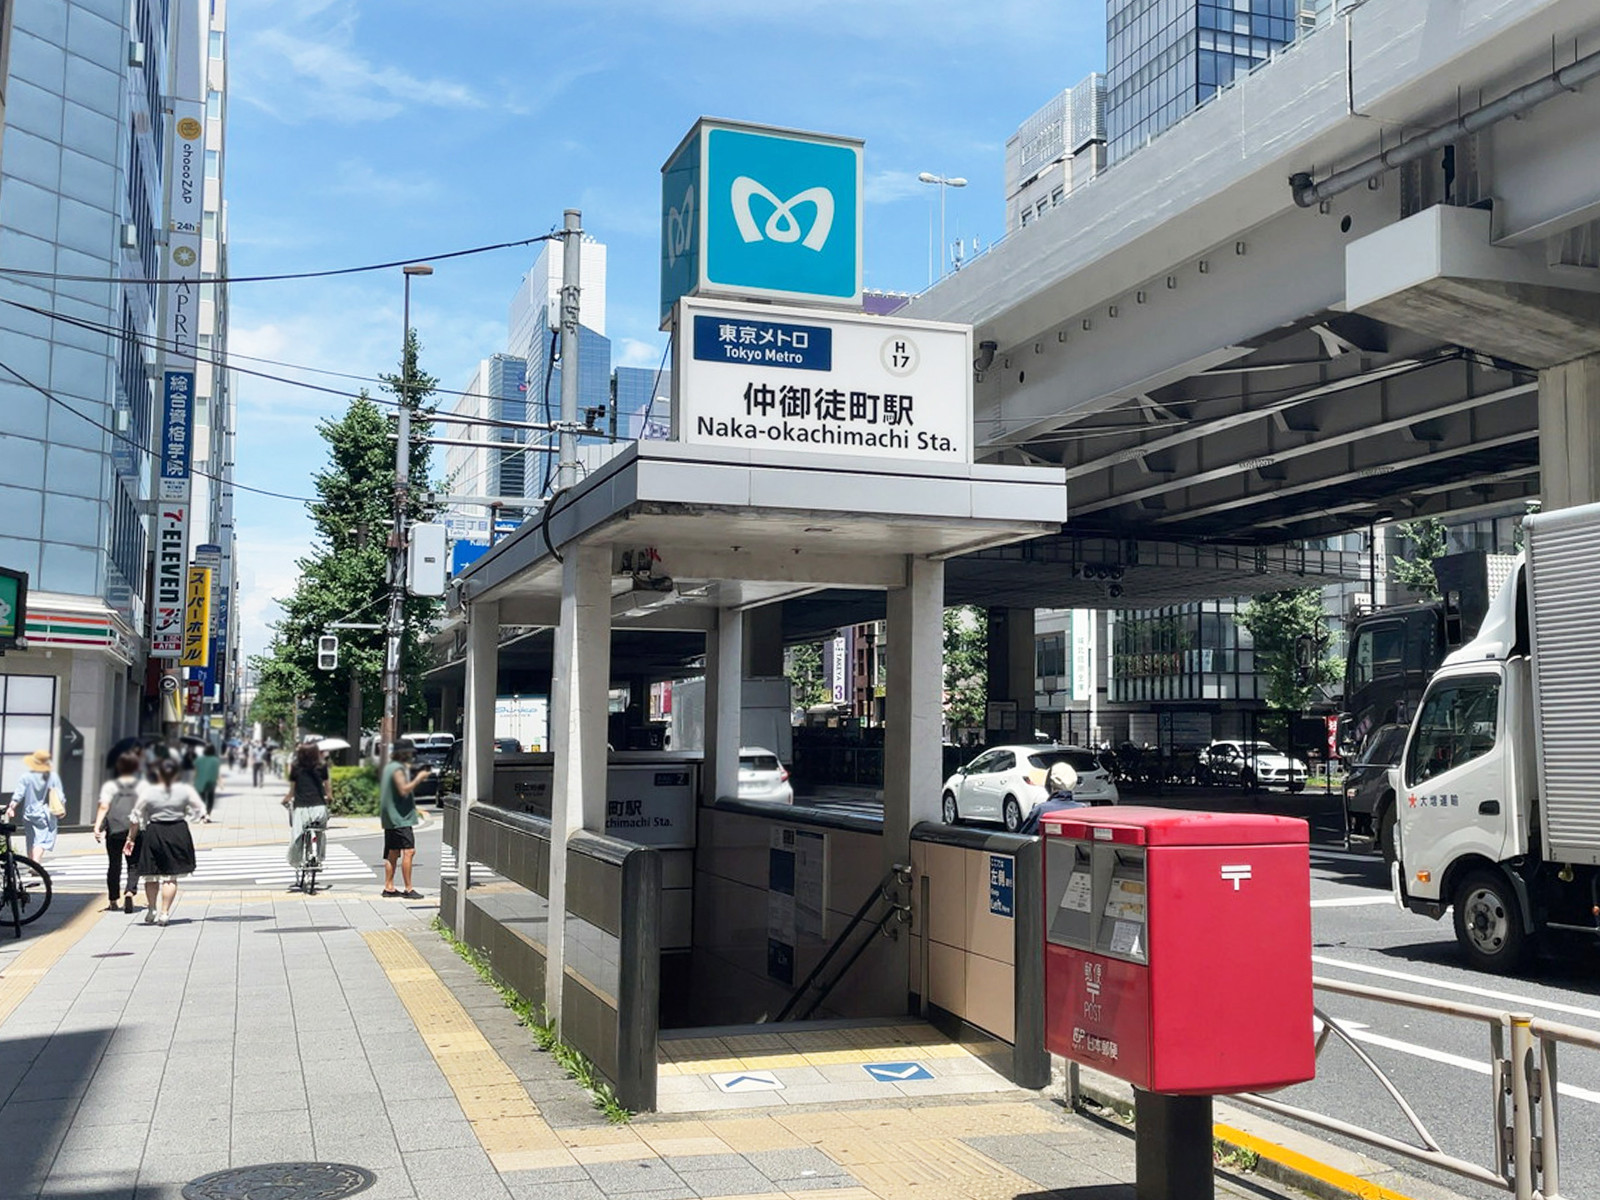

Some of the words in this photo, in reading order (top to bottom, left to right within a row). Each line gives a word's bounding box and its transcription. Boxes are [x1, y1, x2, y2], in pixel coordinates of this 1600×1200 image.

[182, 143, 194, 204] chocoZAP
[176, 221, 195, 232] 24h
[174, 276, 191, 354] APRE
[718, 324, 809, 349] 東京メトロ
[895, 341, 906, 353] H
[724, 344, 763, 364] Tokyo
[764, 347, 803, 364] Metro
[892, 355, 910, 369] 17
[743, 382, 915, 427] 仲御徒町駅
[167, 375, 188, 476] 総合資格学院
[697, 416, 909, 449] Naka-okachimachi
[917, 431, 958, 452] Sta.
[184, 572, 205, 661] スーパーホテル
[835, 685, 843, 700] 3
[608, 799, 642, 817] 町駅
[653, 816, 673, 828] Sta.
[1083, 1001, 1102, 1023] POST
[1087, 1035, 1119, 1060] 日本郵便
